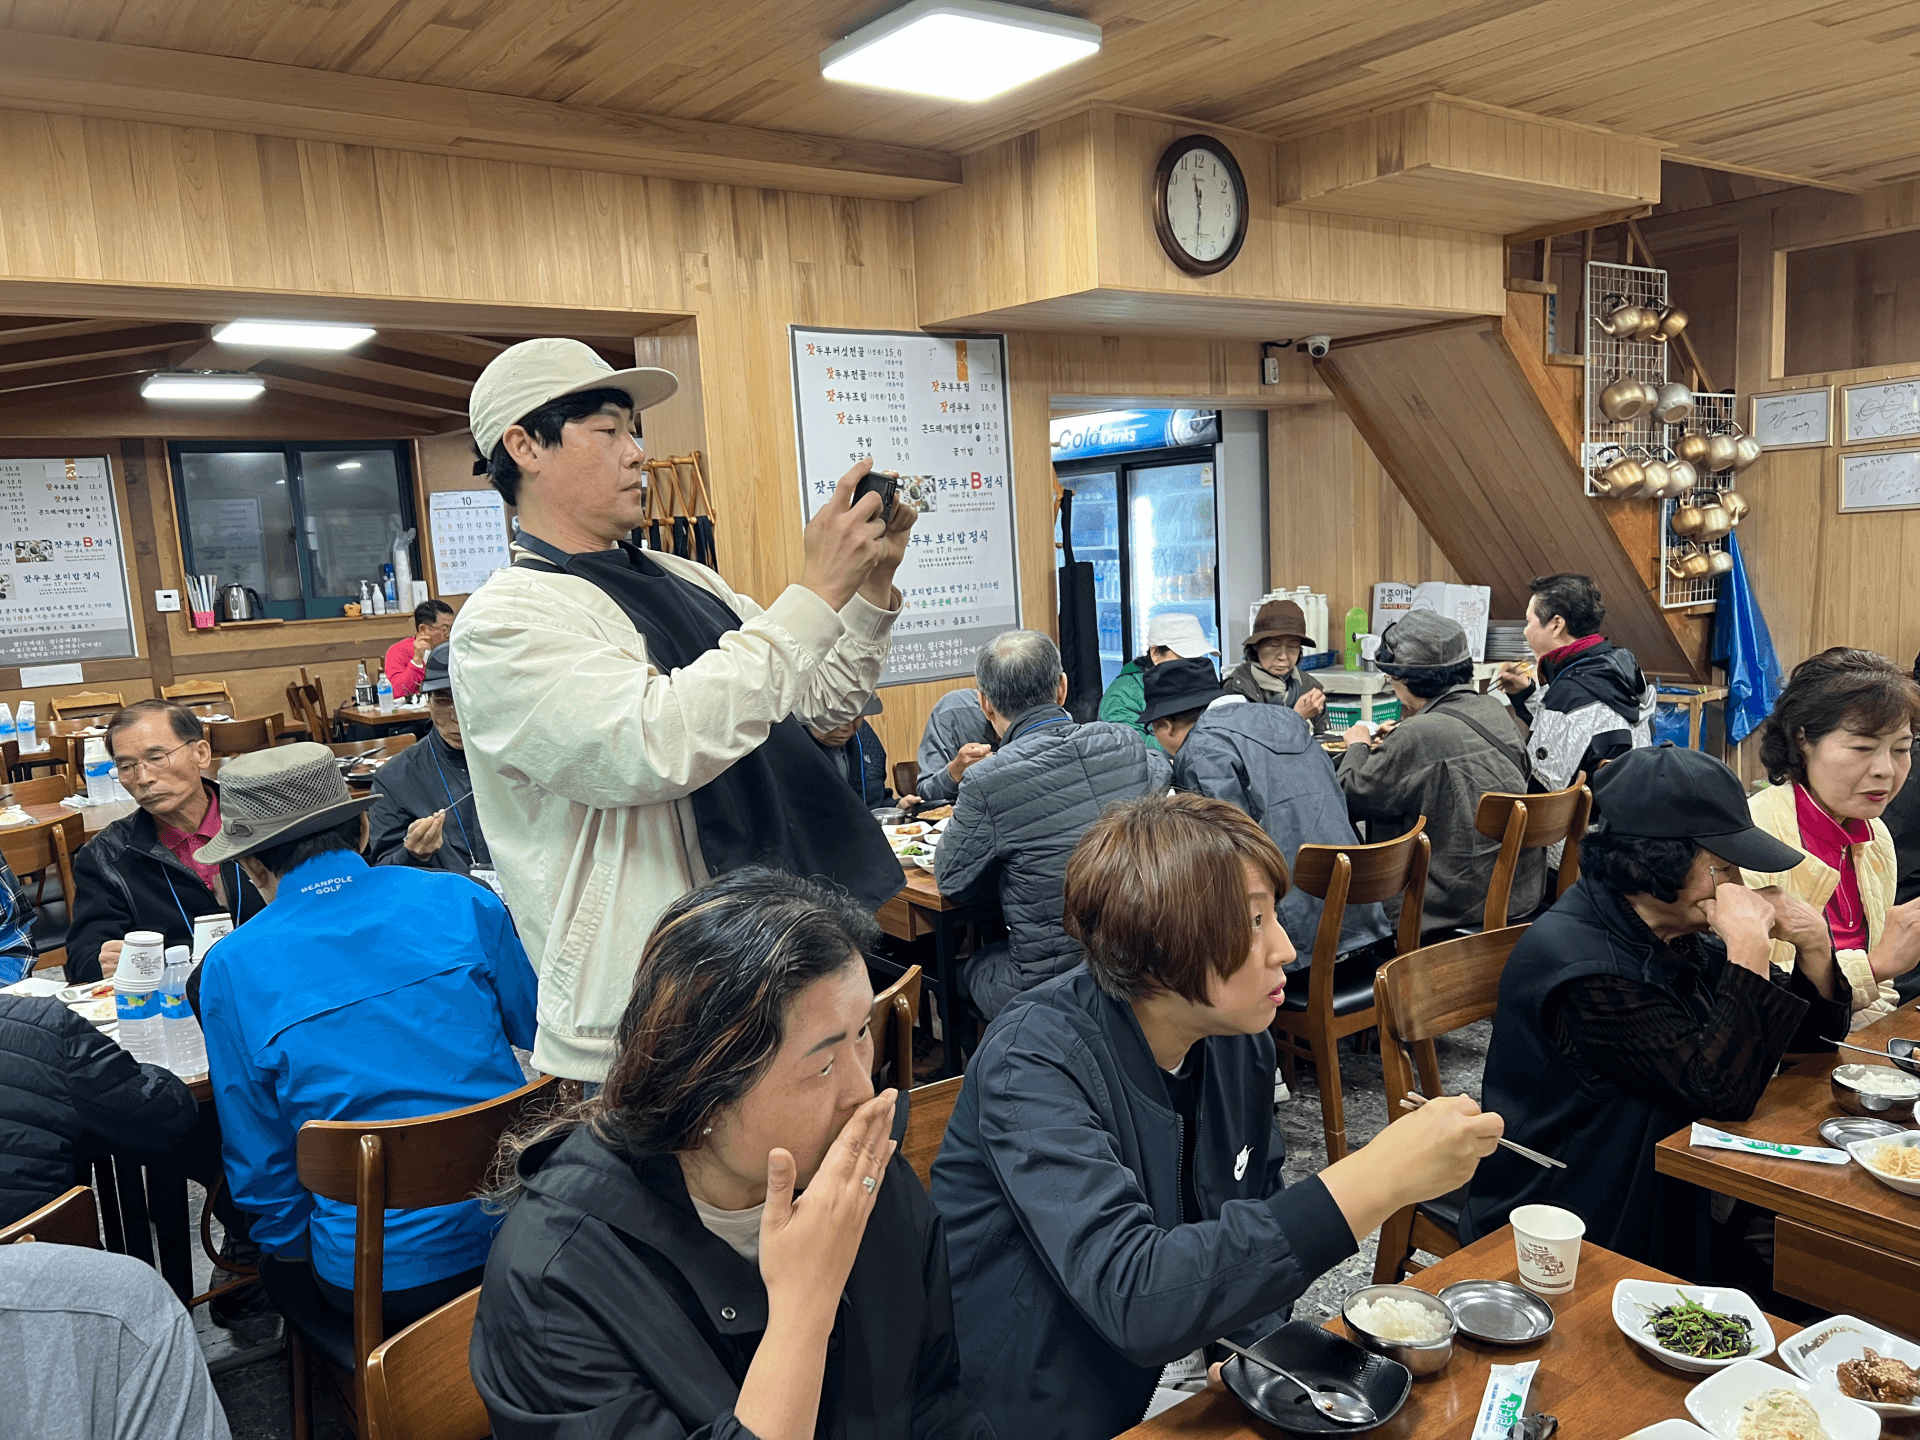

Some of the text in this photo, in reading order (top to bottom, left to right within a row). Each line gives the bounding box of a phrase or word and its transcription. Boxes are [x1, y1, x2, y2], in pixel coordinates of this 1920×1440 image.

[1181, 156, 1187, 170] 11
[1195, 154, 1204, 168] 12
[1213, 163, 1216, 177] 1
[1221, 180, 1227, 193] 2
[1225, 204, 1230, 218] 3
[1221, 225, 1225, 238] 4
[1196, 245, 1201, 258] 6
[1210, 241, 1216, 254] 5
[885, 348, 902, 358] 15.0
[887, 371, 904, 380] 12.0
[981, 384, 995, 392] 12.0
[888, 393, 904, 402] 10.0
[981, 403, 996, 412] 10.0
[890, 415, 906, 424] 10.0
[892, 438, 908, 447] 10.0
[1060, 425, 1103, 449] Cold
[897, 453, 910, 461] 9.0
[461, 496, 472, 505] 10
[906, 530, 988, 547] 두부 보리밥 정식
[1386, 589, 1411, 602] 종이컵
[301, 876, 353, 893] BEANPOLE
[316, 884, 341, 895] GOLF
